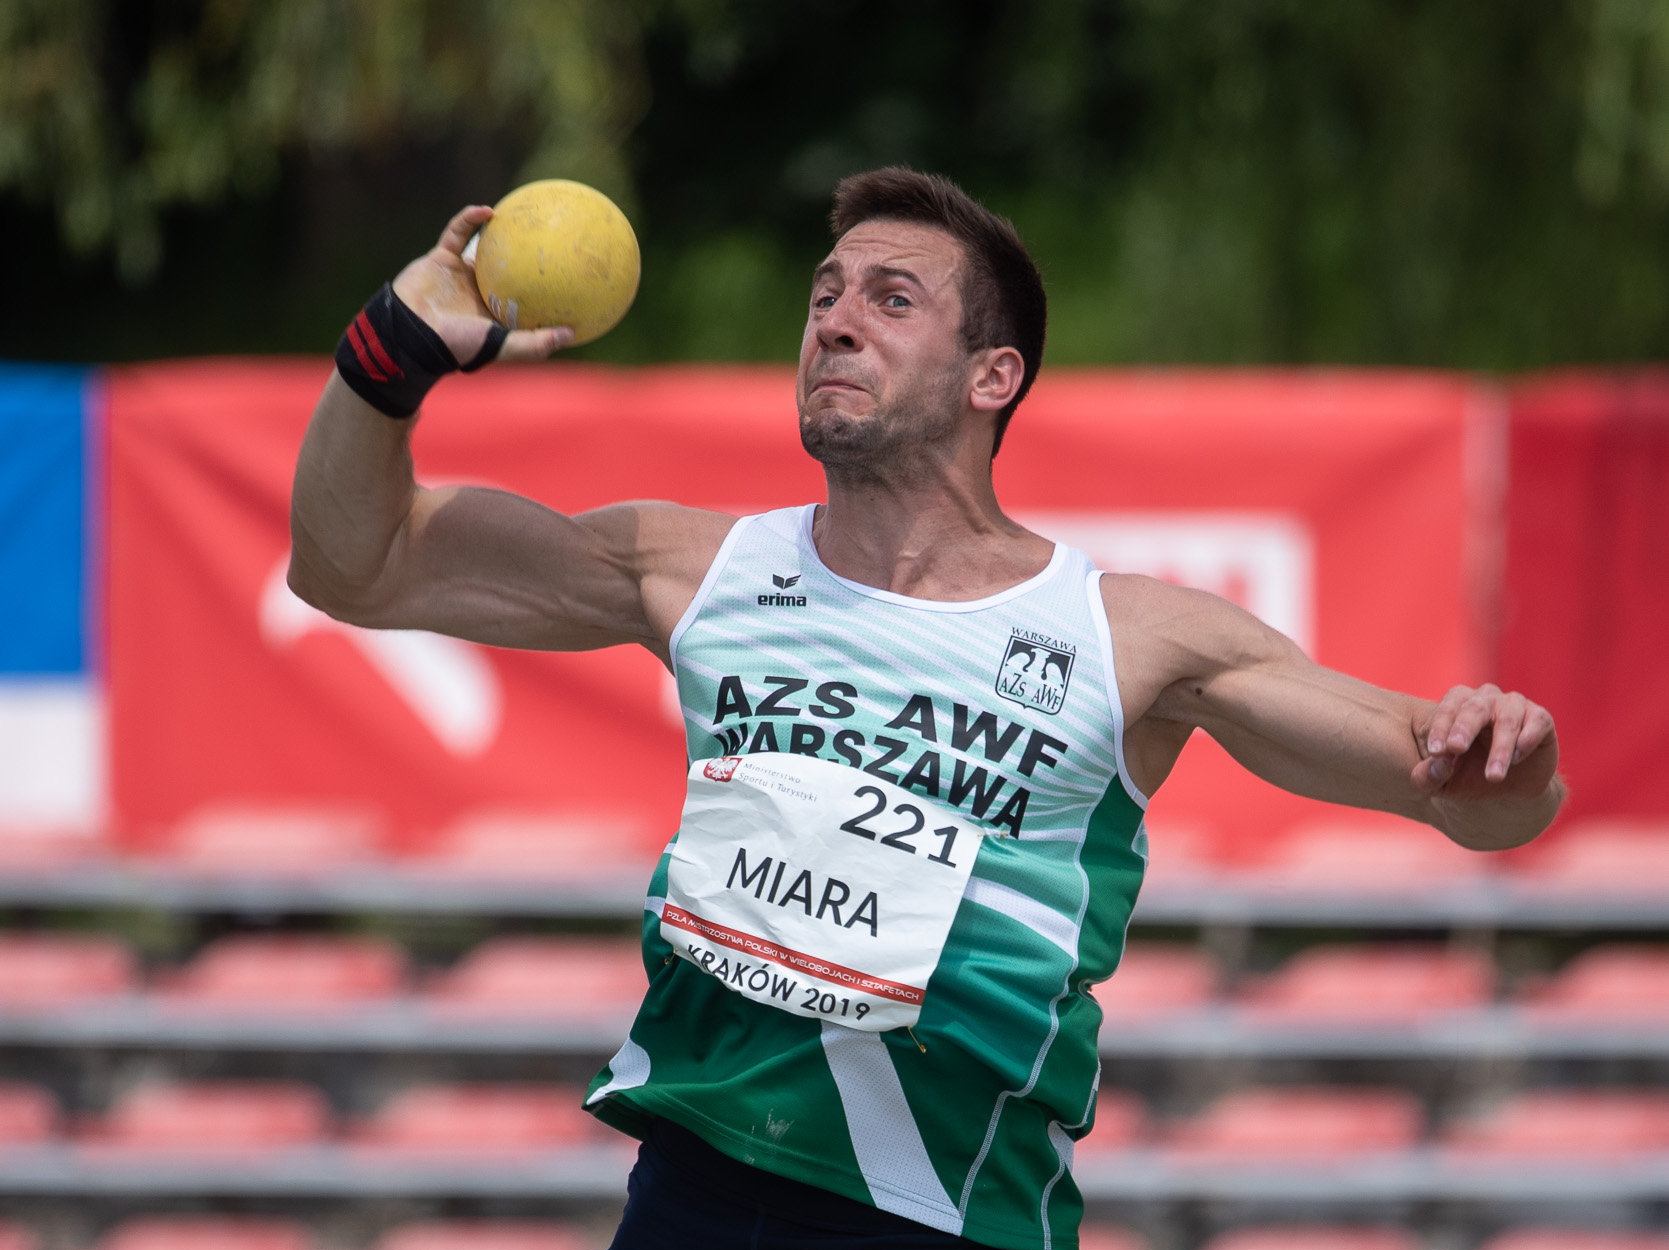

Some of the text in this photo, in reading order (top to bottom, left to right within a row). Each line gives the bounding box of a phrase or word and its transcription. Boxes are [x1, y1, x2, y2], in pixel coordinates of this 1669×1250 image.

[757, 592, 807, 607] erima
[1011, 626, 1077, 654] WARSZAWA
[712, 675, 1070, 779] AZS AWF
[998, 673, 1062, 710] AZS AWF
[713, 721, 1032, 840] WARSZAWA
[737, 772, 768, 787] Sportu
[777, 783, 819, 803] Turystyki
[743, 763, 801, 784] Ministerstwo
[839, 785, 958, 869] 221
[725, 848, 880, 938] MIARA
[666, 910, 688, 924] PZLA
[687, 920, 744, 947] MISTRZOSTWA
[744, 940, 778, 958] POLSKI
[778, 952, 789, 962] W
[789, 955, 856, 985] WIELOBOJACH
[860, 979, 920, 1001] SZTAFETACH
[687, 944, 871, 1021] KRAKÓW 2019
